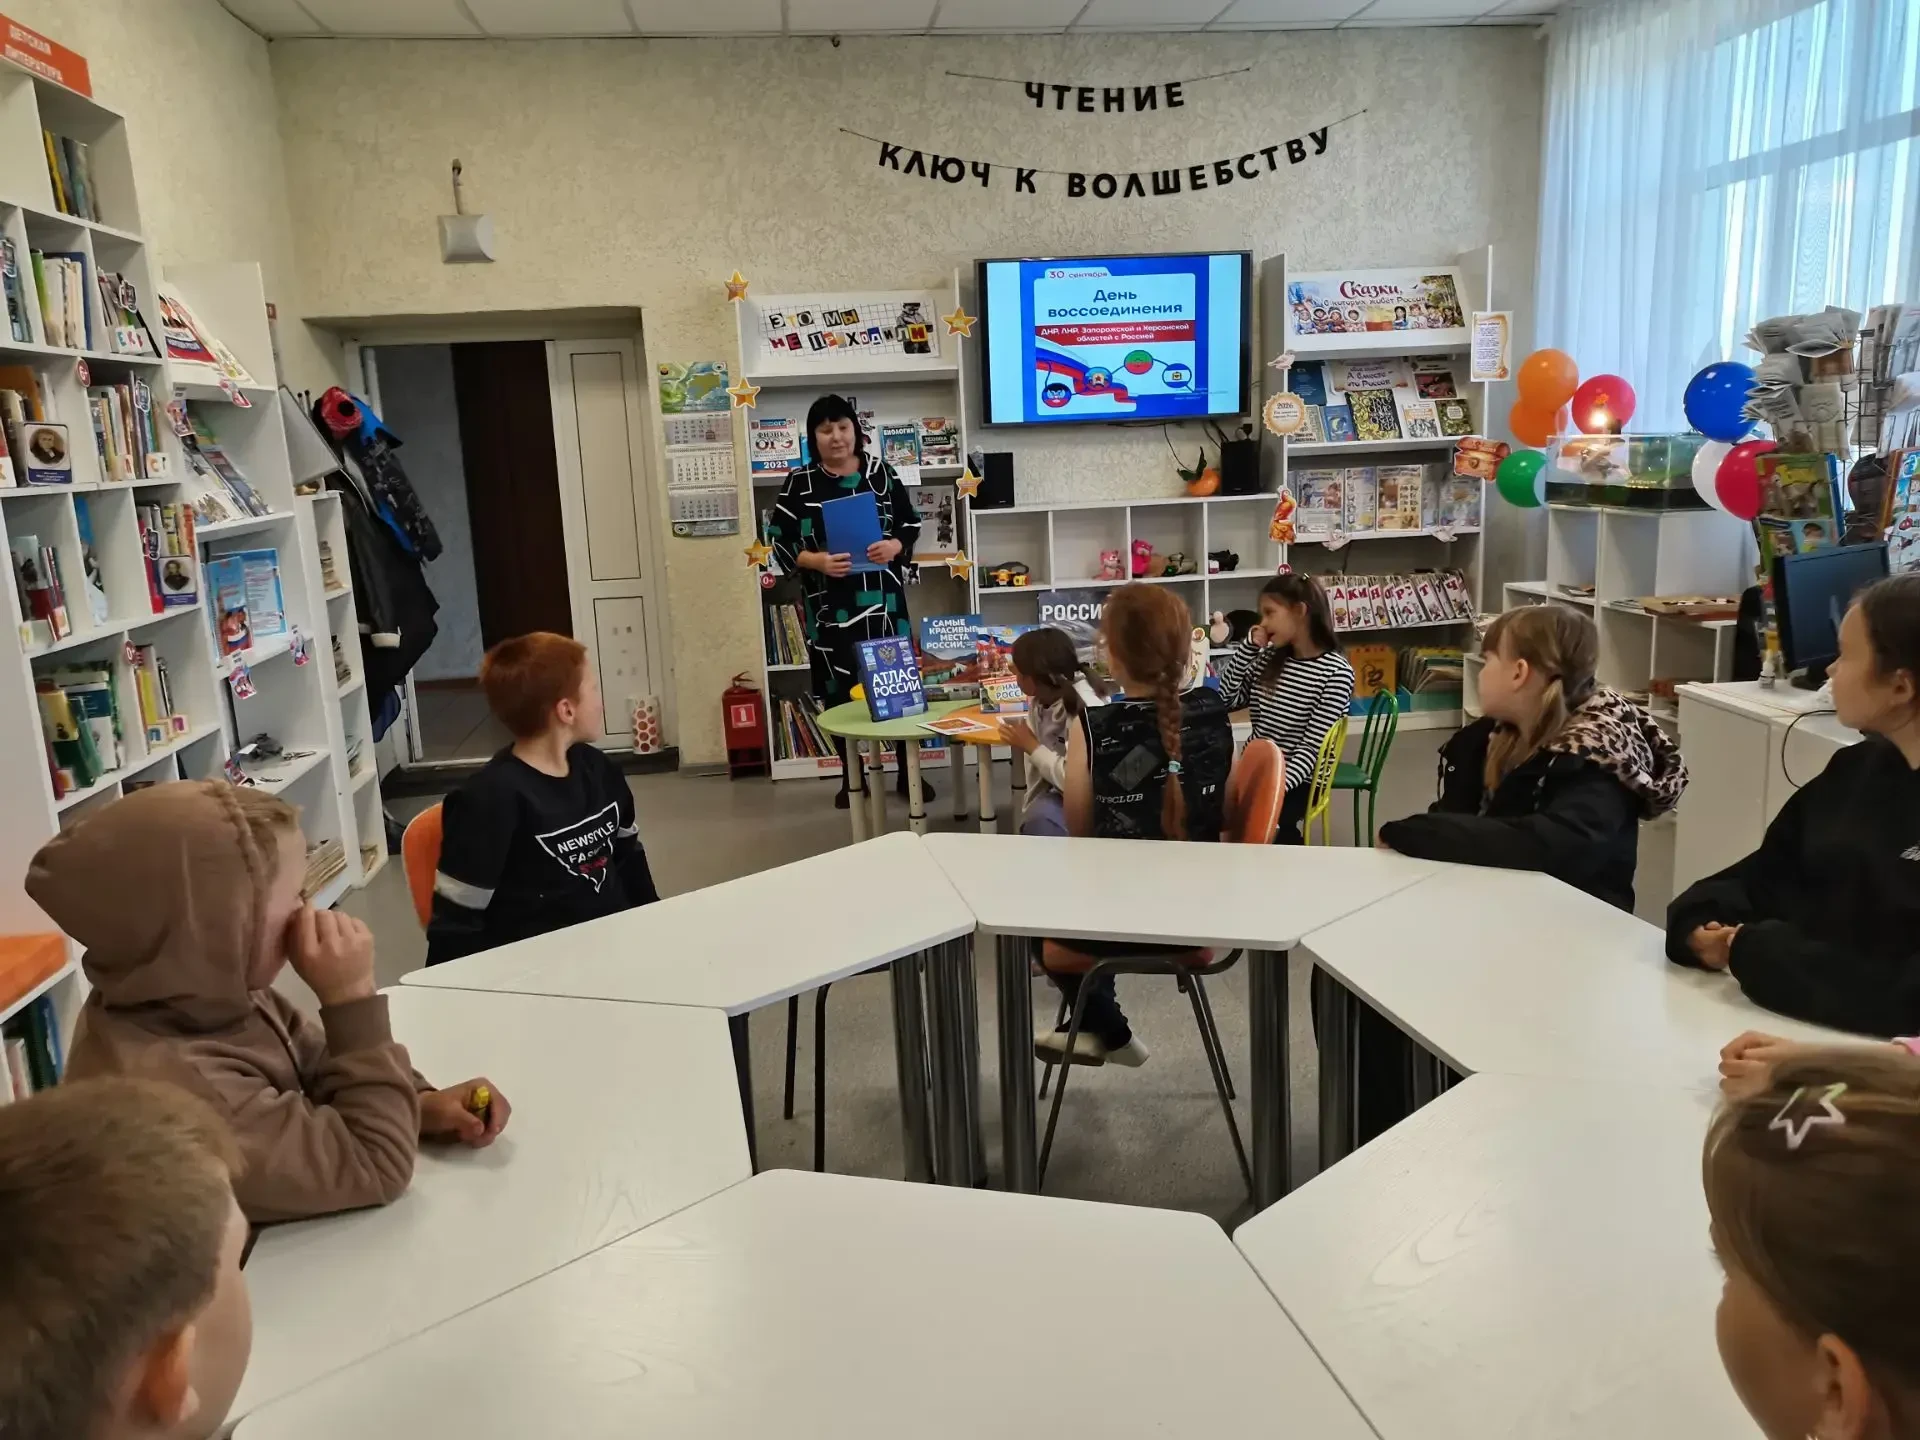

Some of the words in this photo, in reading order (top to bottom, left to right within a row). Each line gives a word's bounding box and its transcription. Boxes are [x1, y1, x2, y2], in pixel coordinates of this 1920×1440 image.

[1025, 81, 1185, 113] ЧТЕНИЕ
[878, 141, 991, 188] КЛЮЧ
[1015, 168, 1037, 194] К
[1067, 126, 1330, 199] ВОЛШЕБСТВУ
[1049, 270, 1065, 279] 30
[1093, 289, 1137, 302] День
[1048, 303, 1183, 318] воссоединения
[756, 430, 791, 438] ФИЗИКА
[763, 460, 788, 469] 2023
[1042, 603, 1102, 621] РОССИ
[932, 619, 965, 627] САМЫЕ
[940, 633, 970, 641] МЕСТА
[872, 667, 919, 687] АТЛАС
[873, 680, 921, 698] РОССИИ
[996, 690, 1023, 699] РОСС
[557, 821, 616, 854] NEWSTYLE
